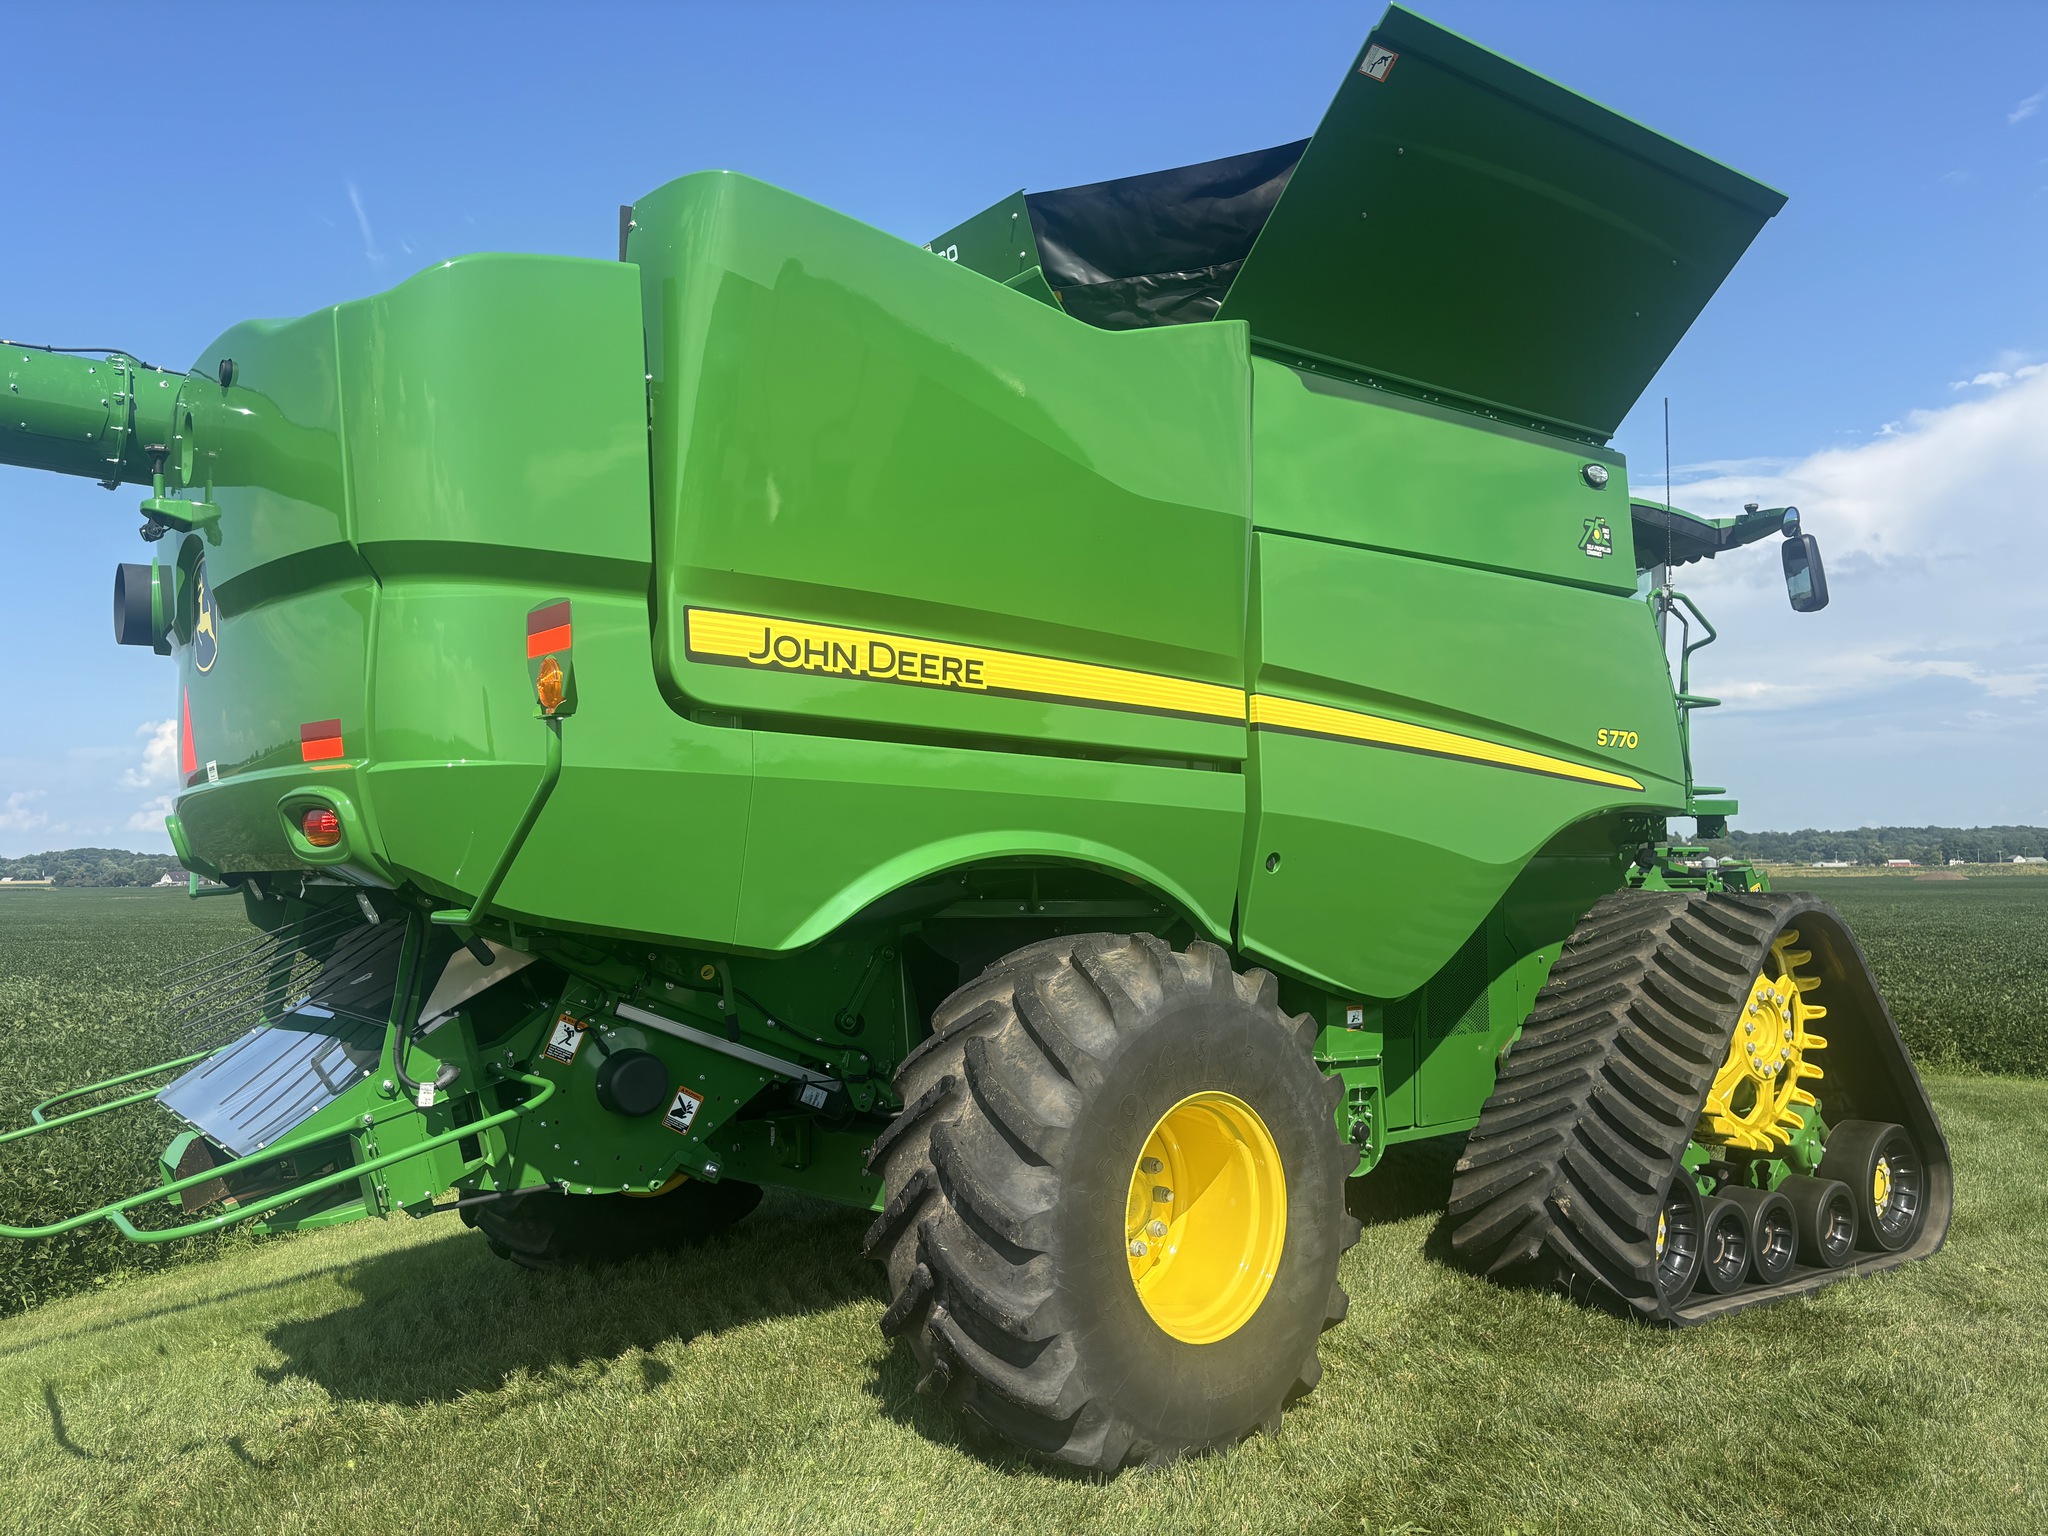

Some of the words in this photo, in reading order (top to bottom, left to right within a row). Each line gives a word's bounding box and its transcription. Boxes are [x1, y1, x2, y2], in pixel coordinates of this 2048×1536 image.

[749, 627, 857, 670] JOHN
[869, 641, 984, 684] DEERE
[1597, 728, 1639, 749] S770
